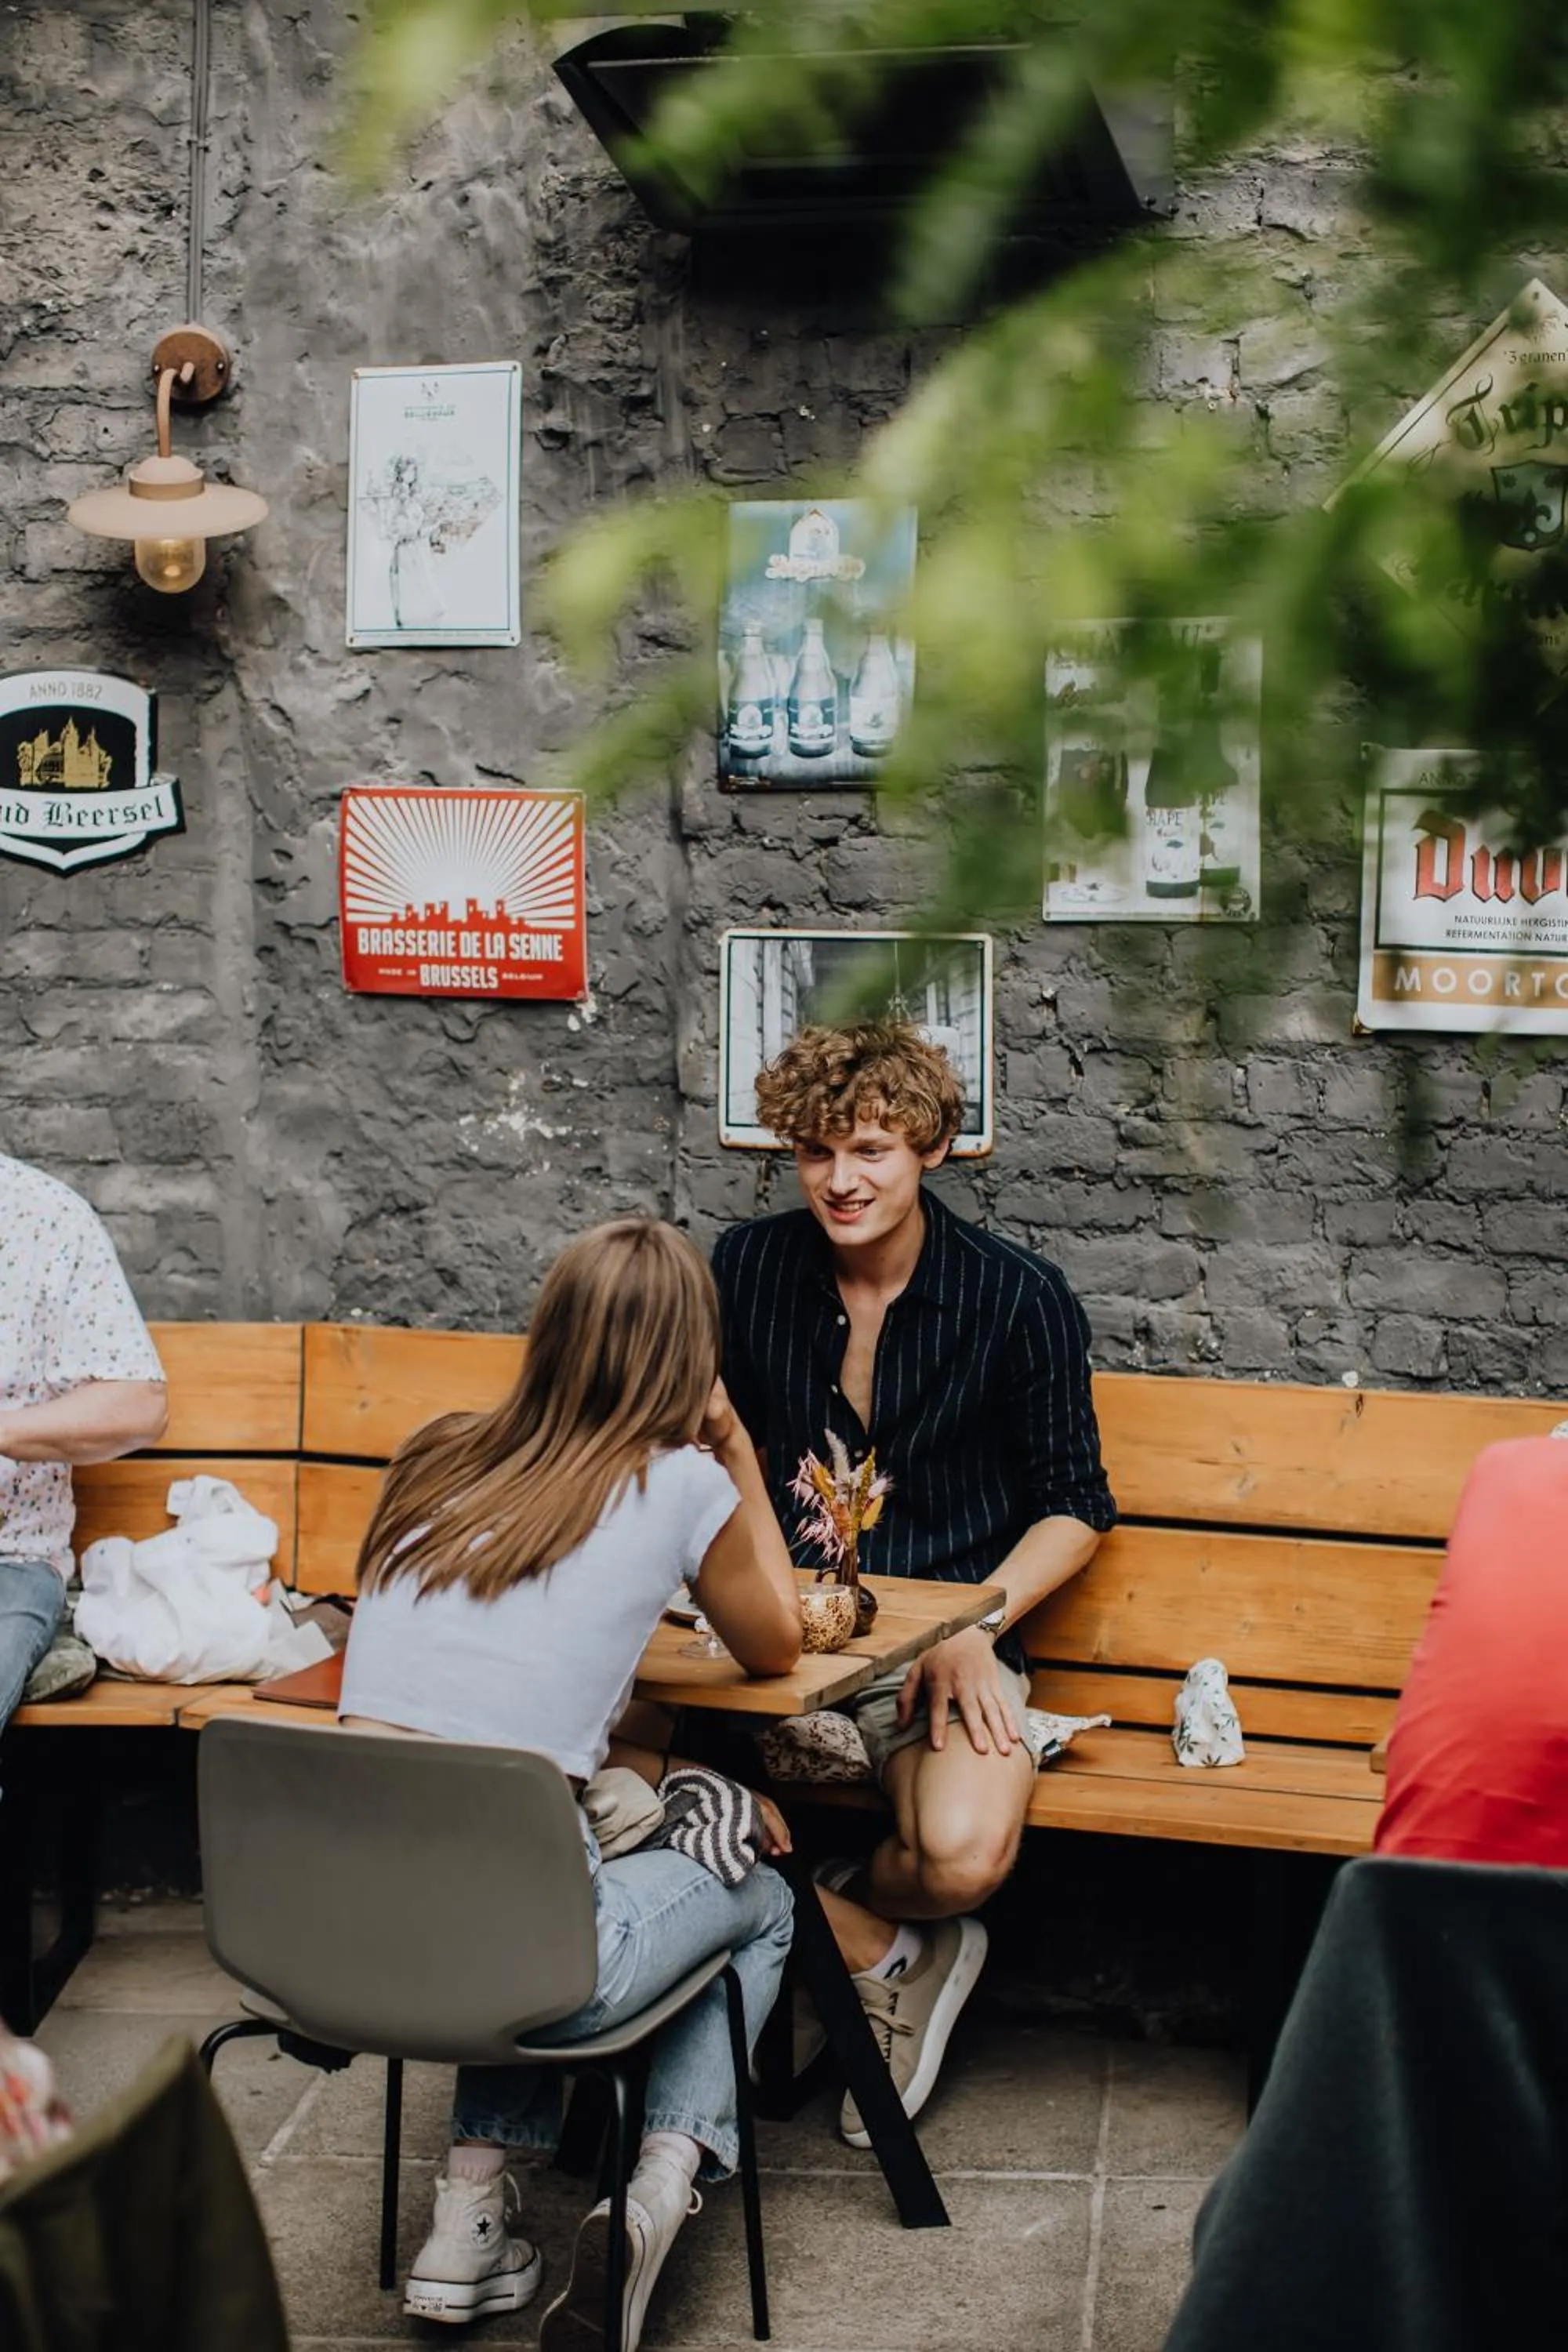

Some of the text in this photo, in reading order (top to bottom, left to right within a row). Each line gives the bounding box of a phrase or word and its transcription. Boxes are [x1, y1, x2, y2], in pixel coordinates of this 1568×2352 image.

[29, 681, 103, 701] ANNO 1882
[42, 795, 165, 828] Beersel
[1412, 810, 1568, 906] Duv
[1454, 915, 1517, 927] NATUURLIJKE
[358, 927, 564, 962] BRASSERIE DE LA SENNE
[1446, 929, 1532, 942] REFERMENTATION
[419, 963, 499, 989] BRUSSELS
